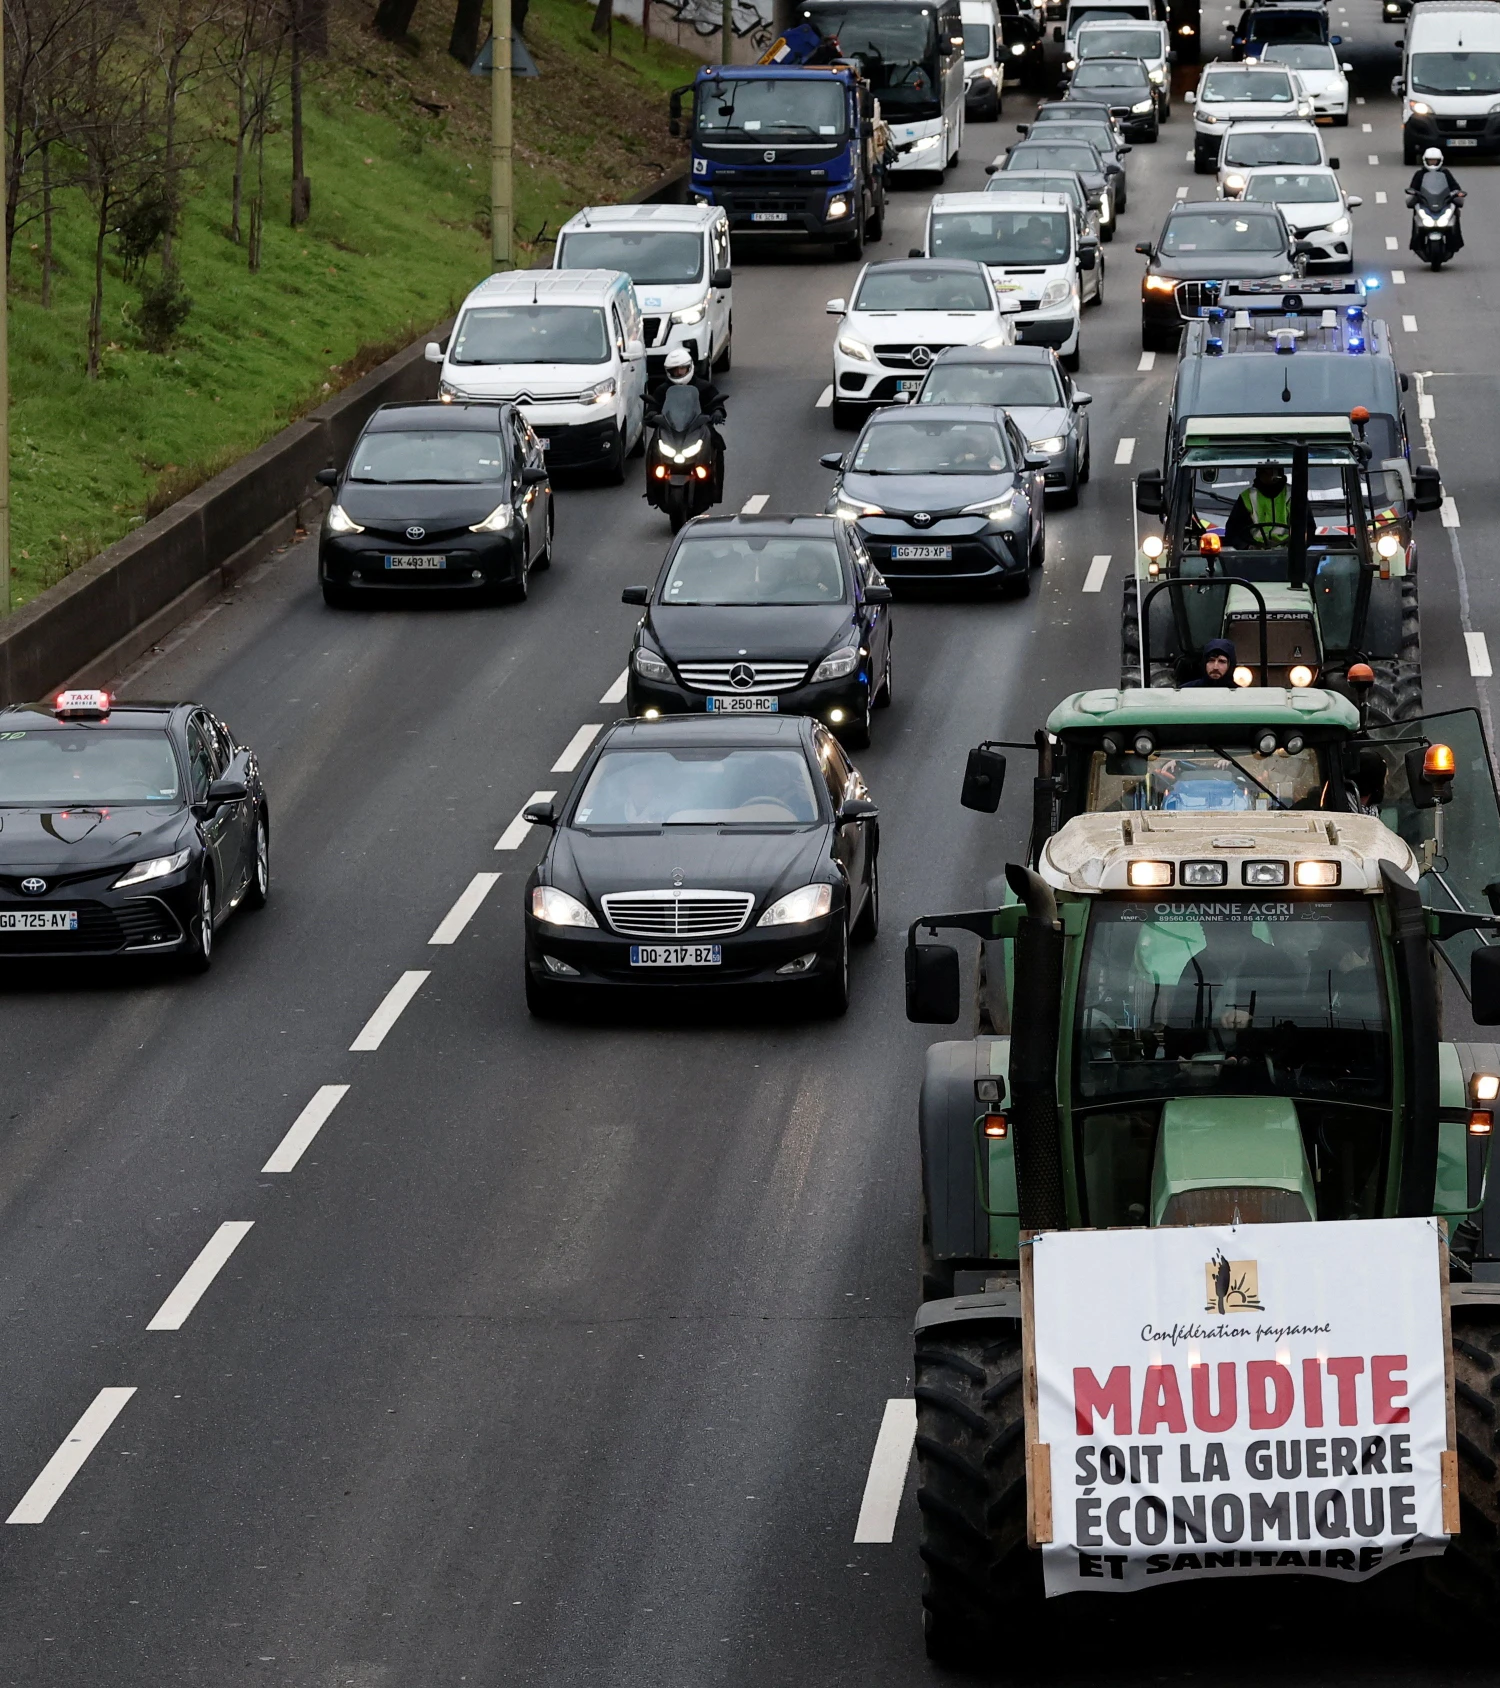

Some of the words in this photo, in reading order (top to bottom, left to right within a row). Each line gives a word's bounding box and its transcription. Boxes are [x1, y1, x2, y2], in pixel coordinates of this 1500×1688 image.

[392, 557, 438, 567] EK-493-YL
[897, 547, 945, 557] GG-773-XP
[1154, 903, 1242, 915] OUANNE
[1246, 903, 1295, 915] AGRI
[0, 913, 67, 928] GQ-725-AY
[641, 947, 712, 964] DQ-217-BZ
[1140, 1323, 1251, 1346] Confédération
[1255, 1322, 1332, 1342] paysanne
[1073, 1354, 1409, 1436] MAUDITE
[1075, 1445, 1163, 1487] SOIT
[1180, 1442, 1230, 1483] LA
[1245, 1434, 1413, 1481] GUERRE
[1075, 1485, 1418, 1547] ÉCONOMIQUE
[1078, 1552, 1128, 1580] ET
[1145, 1546, 1384, 1575] SANITAIRE
